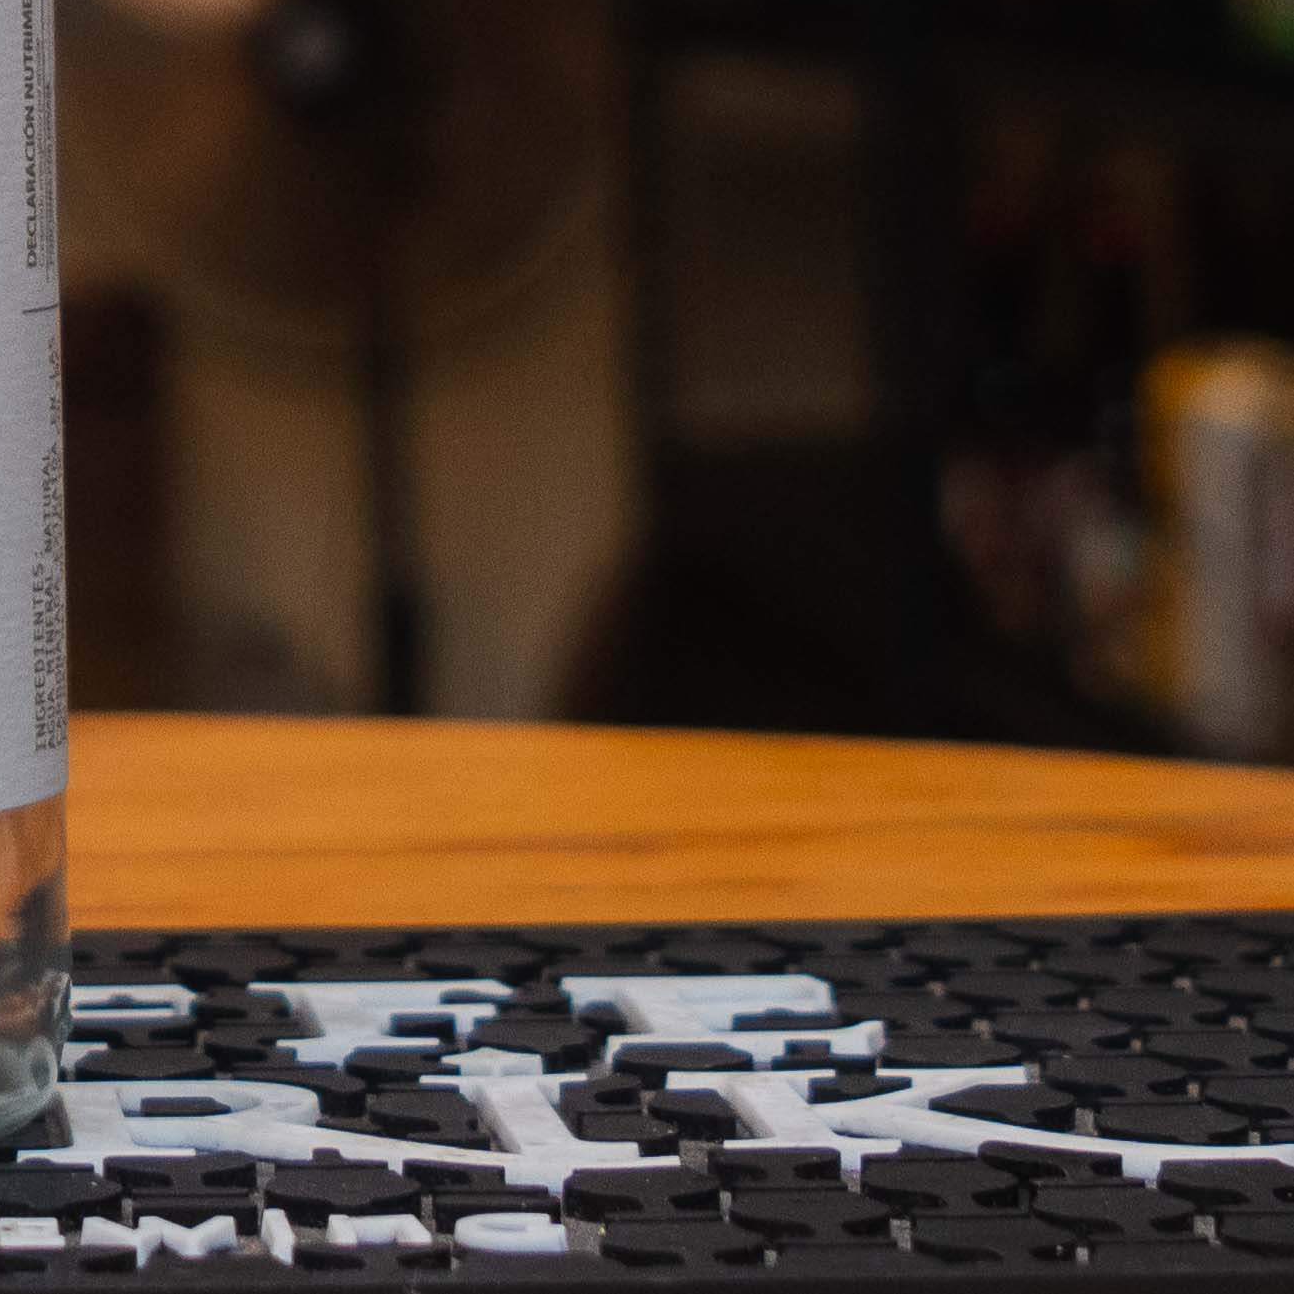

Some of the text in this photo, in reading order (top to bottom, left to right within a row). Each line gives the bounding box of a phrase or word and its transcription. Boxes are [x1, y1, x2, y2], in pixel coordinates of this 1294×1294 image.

[23, 106, 37, 268] DECLARACIÓN
[42, 456, 52, 553] NATURAL
[33, 550, 46, 751] INGREDIENTES:
[45, 575, 54, 676] MINERAL
